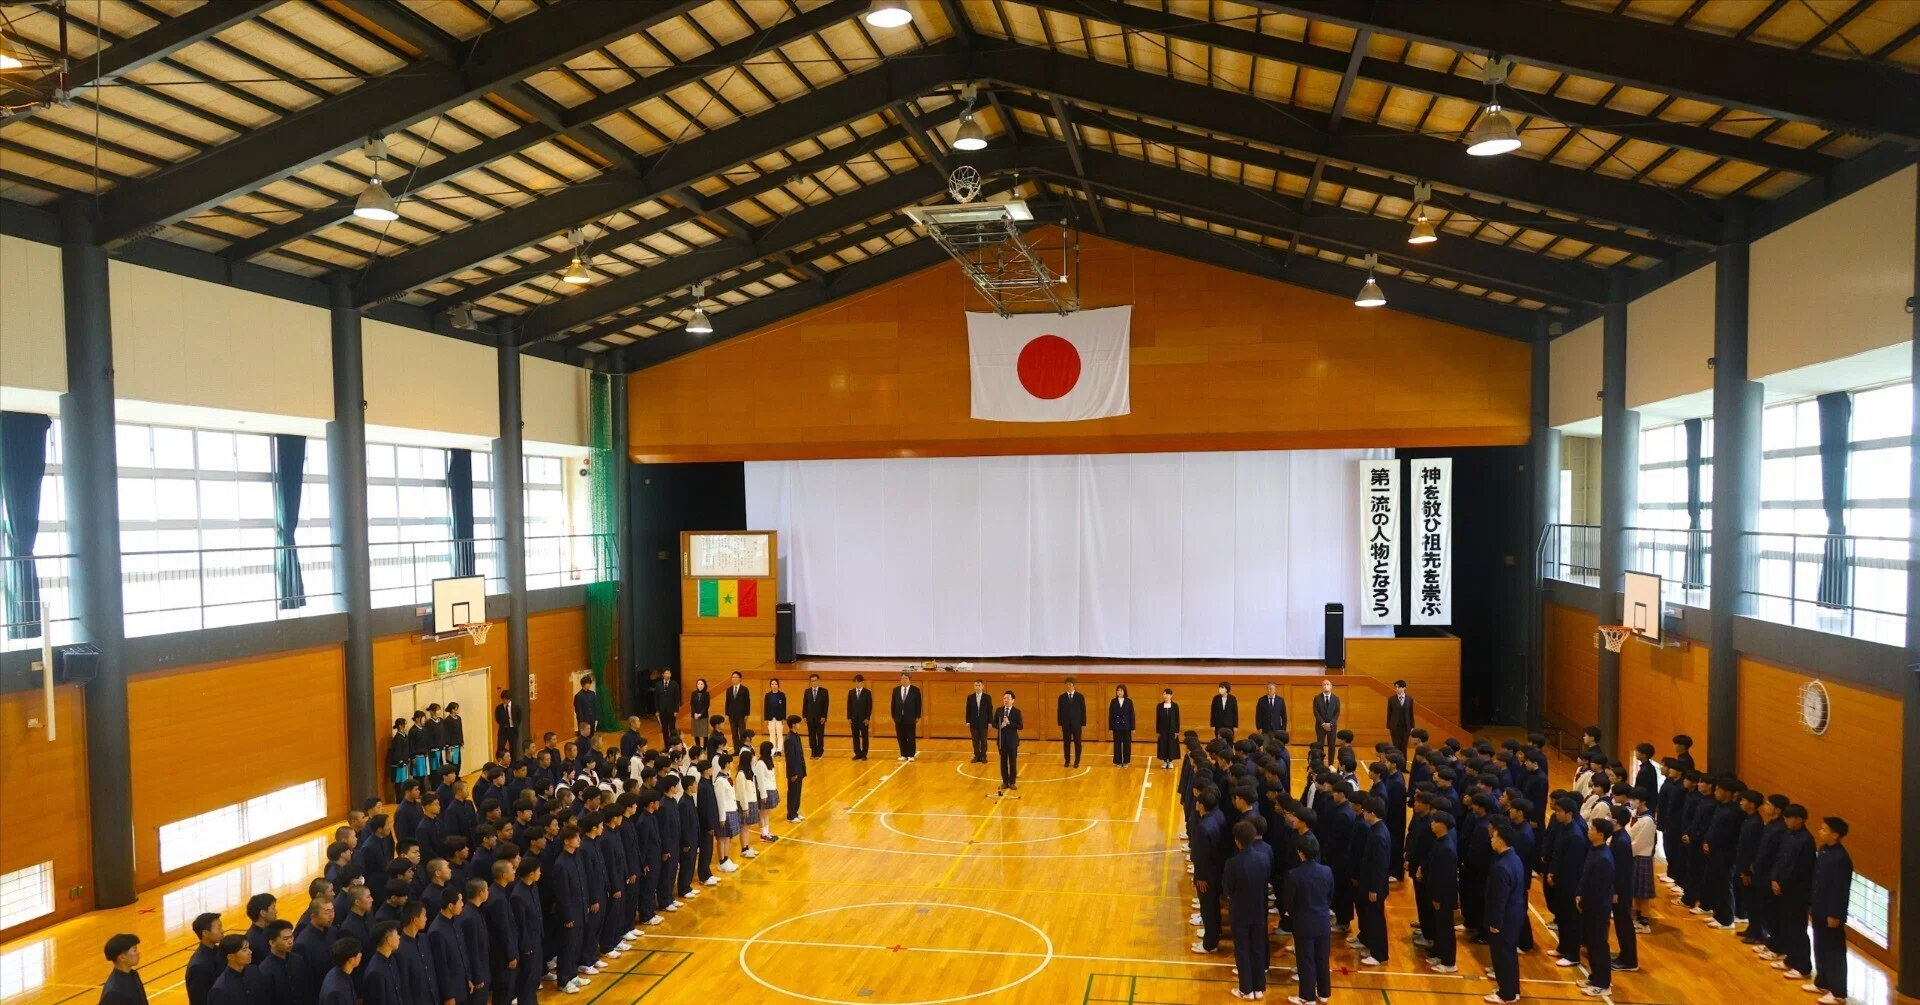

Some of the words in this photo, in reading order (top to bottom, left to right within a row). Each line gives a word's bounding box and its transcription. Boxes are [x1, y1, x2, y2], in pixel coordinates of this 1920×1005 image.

[1370, 467, 1391, 617] 第一流の人物となろう
[1421, 466, 1442, 617] 神を敬ひ祖先を崇ぶ
